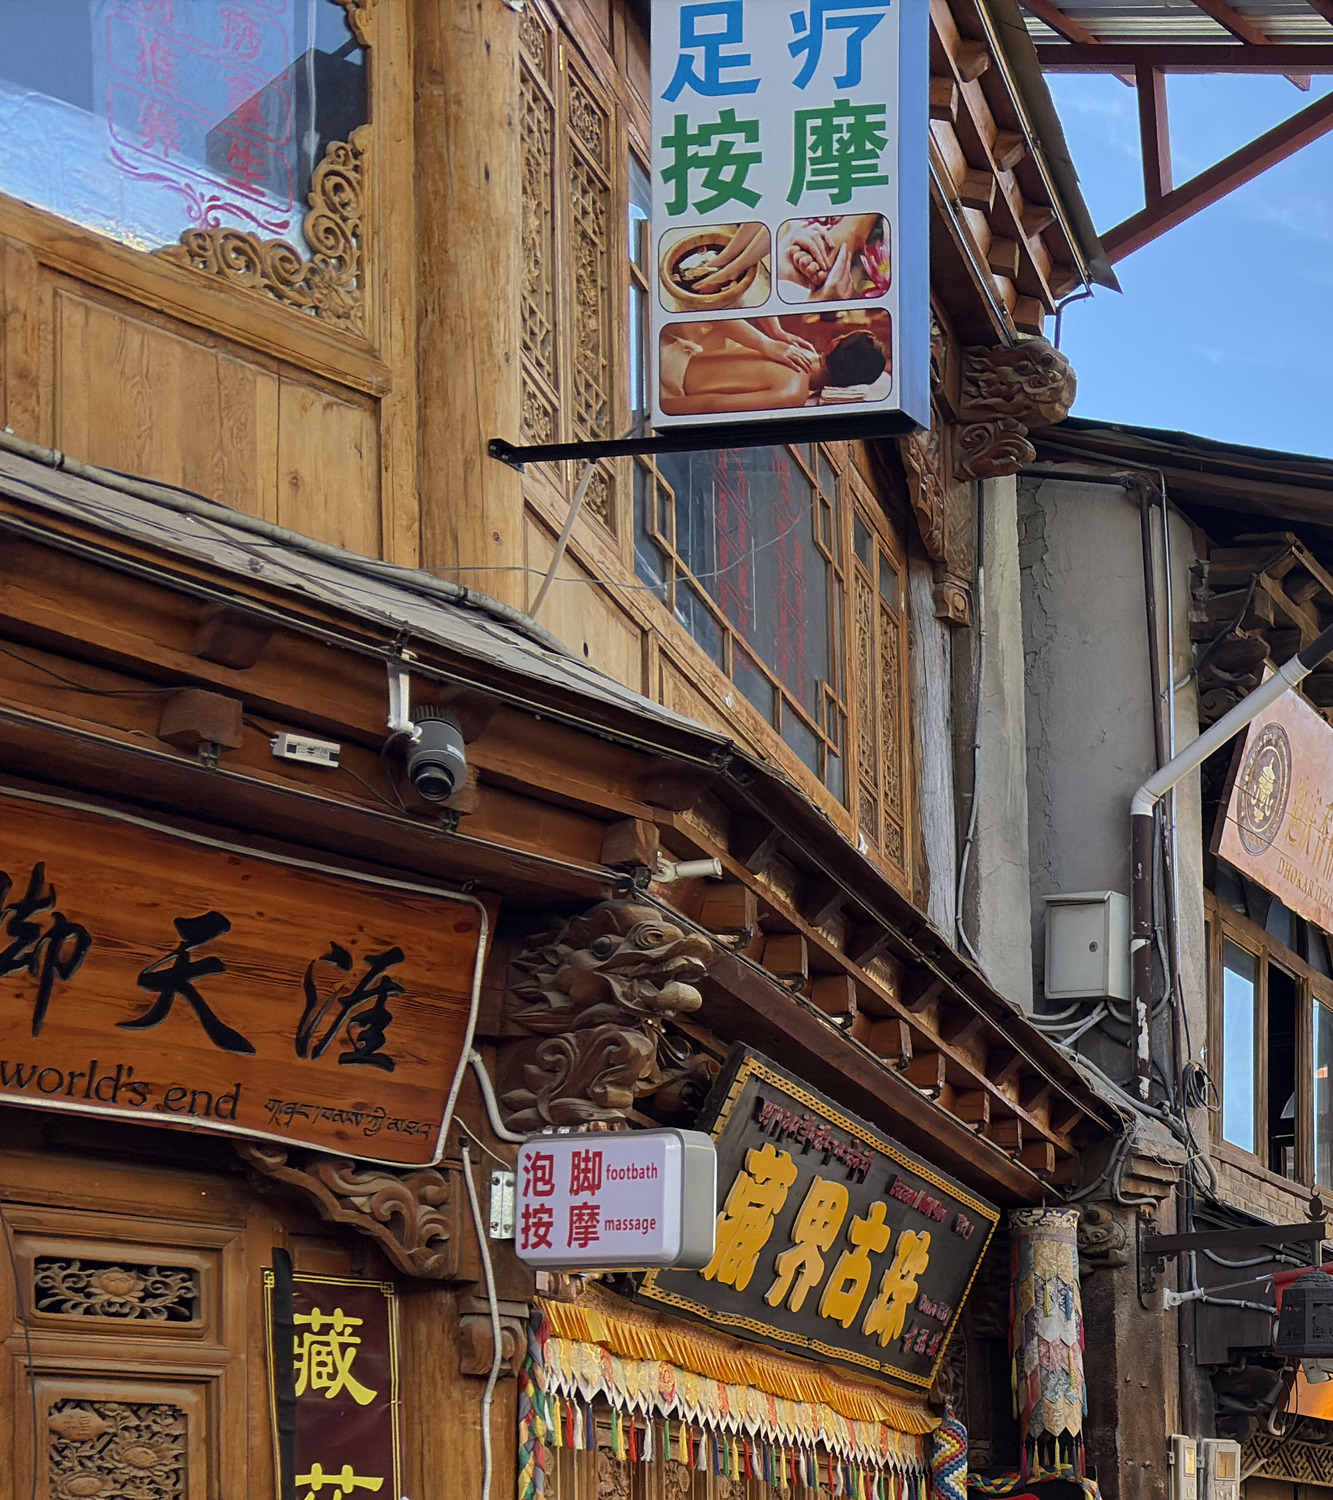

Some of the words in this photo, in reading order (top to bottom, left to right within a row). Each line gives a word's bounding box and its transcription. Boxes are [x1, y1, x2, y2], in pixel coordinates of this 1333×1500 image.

[660, 0, 891, 102] 足疗
[660, 98, 891, 217] 按摩
[0, 1060, 148, 1107] world's
[163, 1083, 242, 1121] end
[522, 1150, 600, 1198] 泡脚
[606, 1161, 659, 1181] footbath
[521, 1201, 600, 1250] 按摩
[604, 1216, 657, 1237] massage
